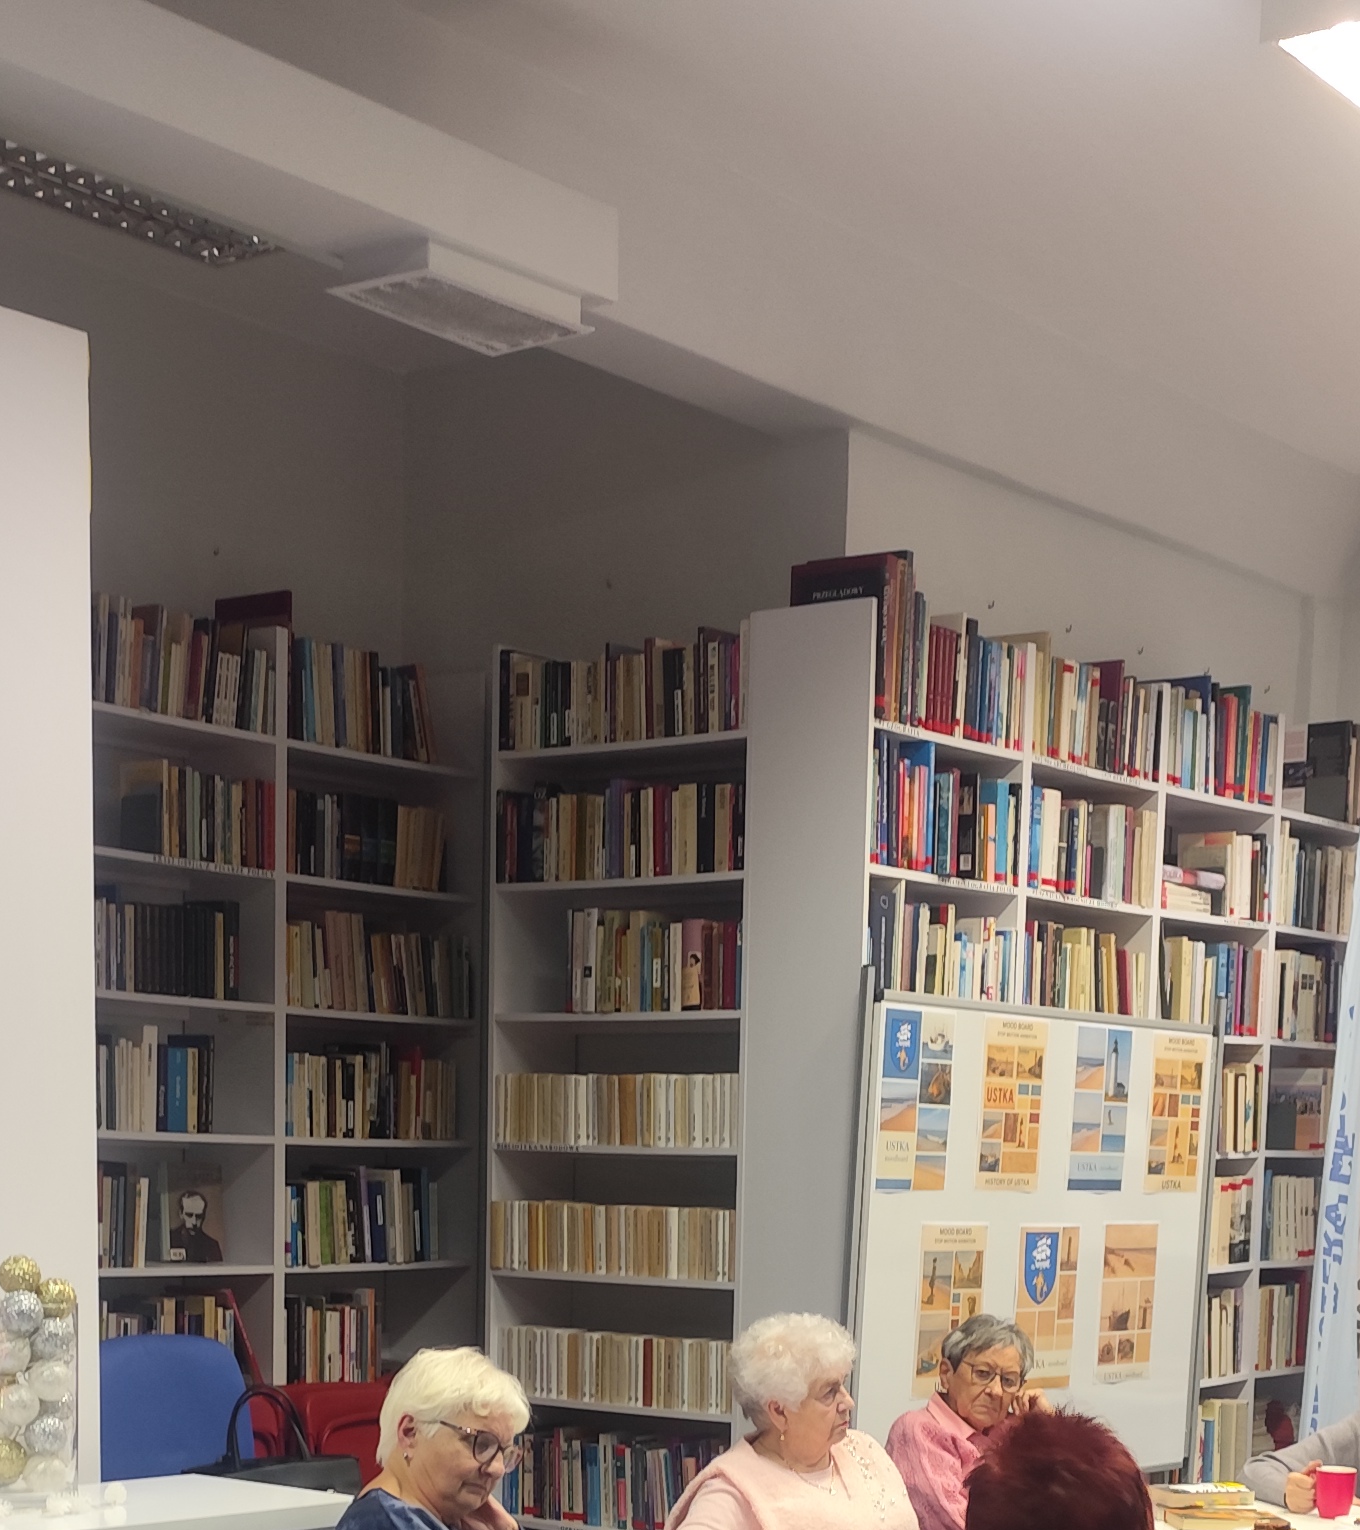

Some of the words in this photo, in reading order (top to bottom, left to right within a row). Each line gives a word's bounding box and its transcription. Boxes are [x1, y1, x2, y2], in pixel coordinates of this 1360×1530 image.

[1002, 1021, 1017, 1030] MOOD
[1018, 1022, 1034, 1031] BOARD
[986, 1086, 1014, 1103] USTKA
[885, 1140, 910, 1152] USTKA
[985, 1178, 1005, 1186] HISTORY
[1006, 1178, 1013, 1186] OF
[1014, 1178, 1030, 1187] USTKA
[1161, 1179, 1182, 1190] USTKA
[939, 1227, 955, 1236] MOOD
[955, 1227, 972, 1236] BOARD
